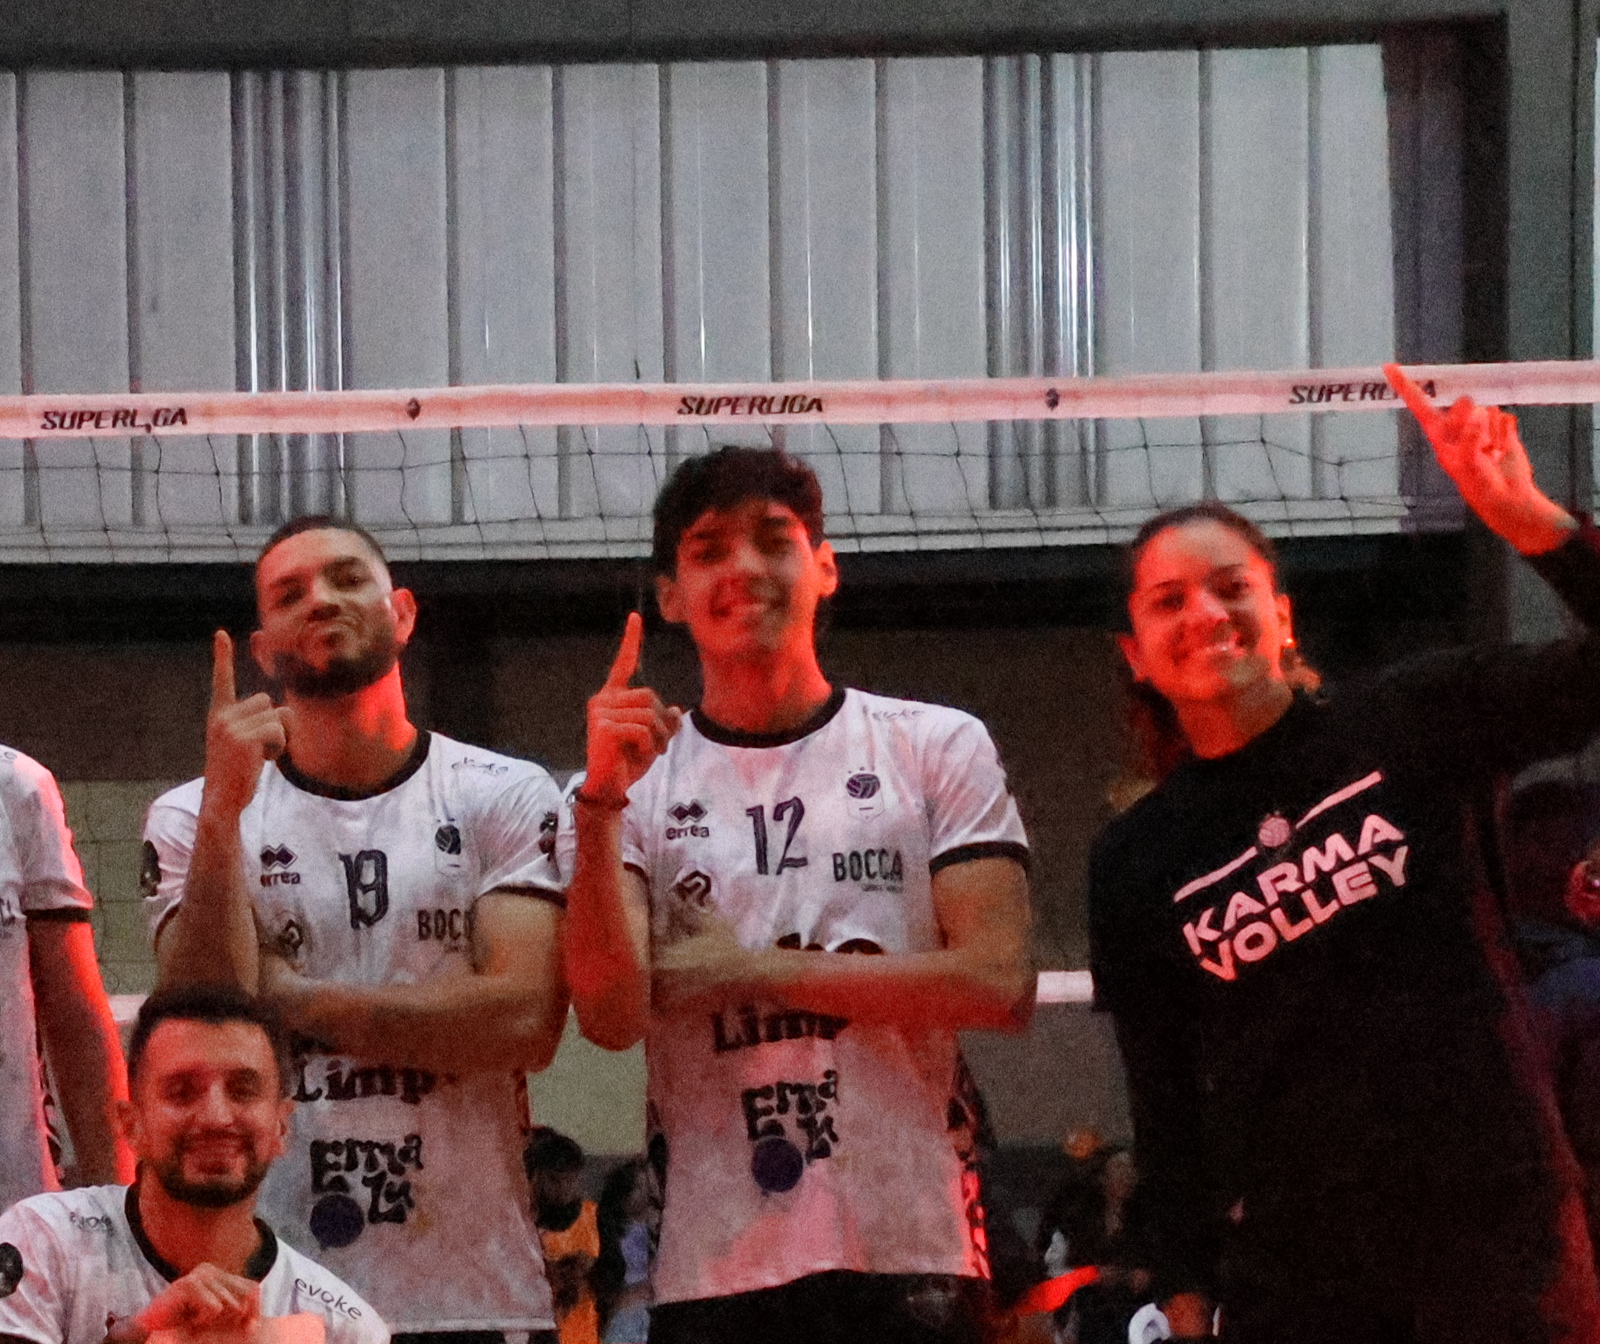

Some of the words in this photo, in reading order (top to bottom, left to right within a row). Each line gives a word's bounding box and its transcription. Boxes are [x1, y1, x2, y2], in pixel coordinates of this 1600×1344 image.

[677, 394, 824, 417] SUPERLIGA
[1288, 379, 1437, 404] SUPERLA
[41, 407, 188, 433] SUPERLGA
[666, 824, 710, 840] errea
[745, 796, 809, 876] 12
[832, 848, 902, 882] BOCCA
[1182, 813, 1405, 957] KARMA
[1200, 845, 1410, 983] VOLLEY
[295, 1277, 363, 1320] evoke
